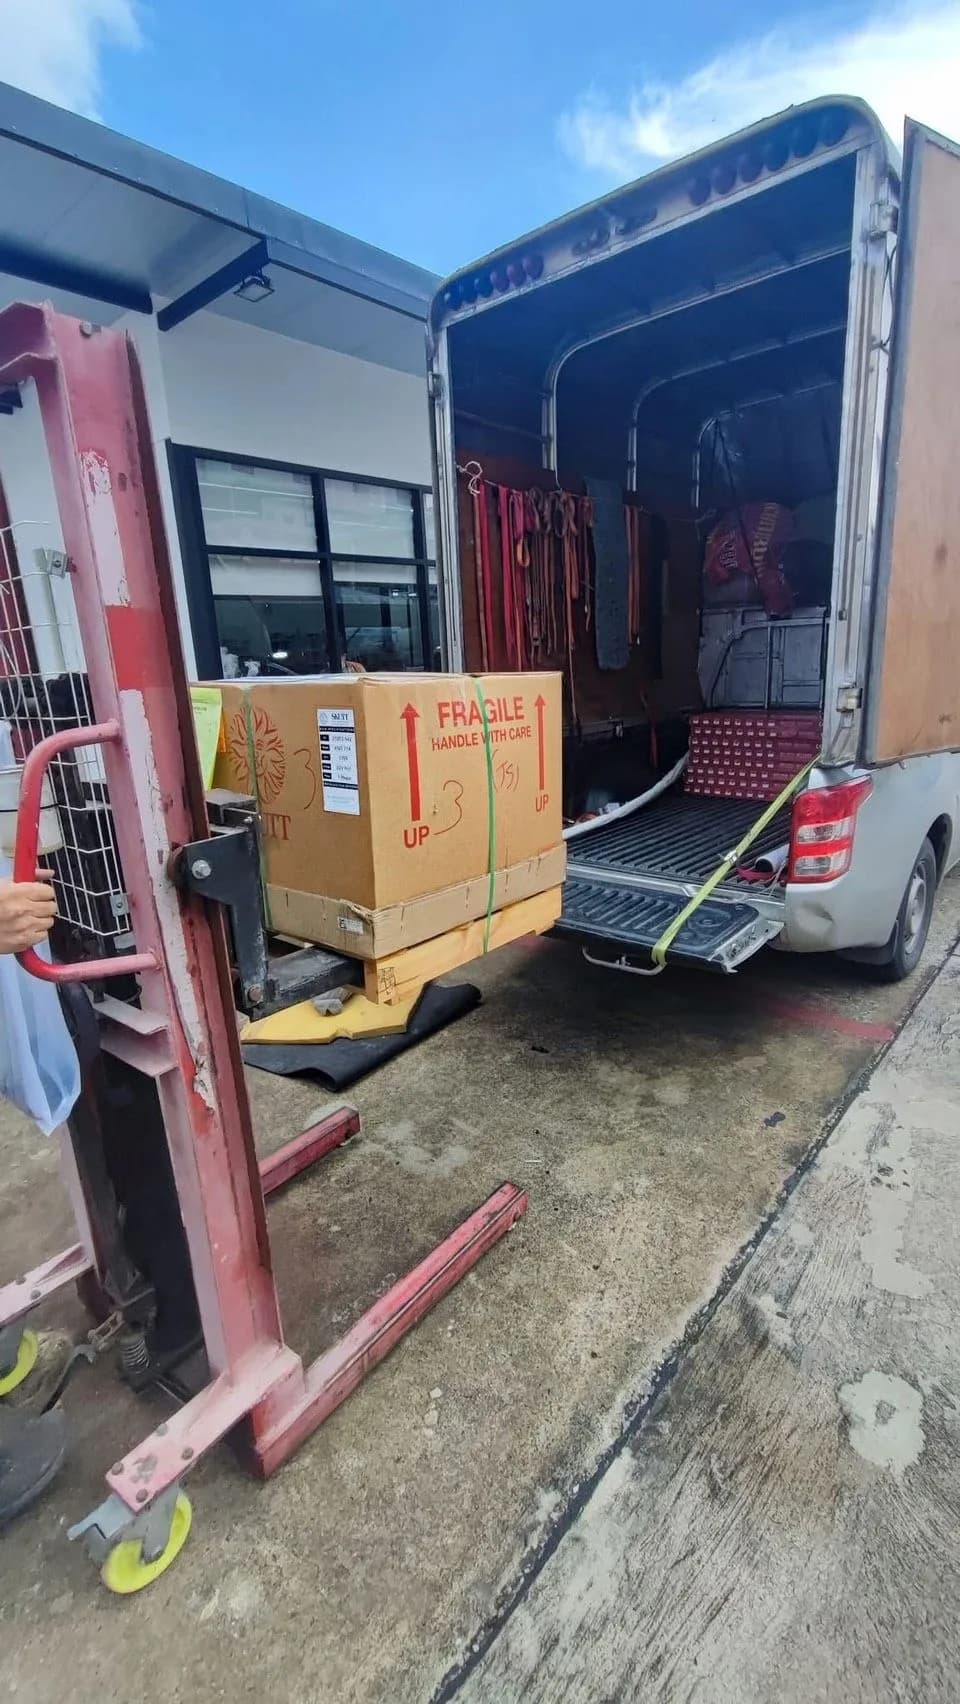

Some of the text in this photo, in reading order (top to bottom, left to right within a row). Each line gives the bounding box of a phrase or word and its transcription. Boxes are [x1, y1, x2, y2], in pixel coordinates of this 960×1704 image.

[437, 696, 525, 729] FRAGILE
[431, 732, 479, 752] HANDLE
[509, 725, 532, 740] CARE
[294, 748, 316, 809] 3
[433, 779, 464, 836] 3
[535, 794, 549, 813] UP
[404, 825, 429, 849] UP
